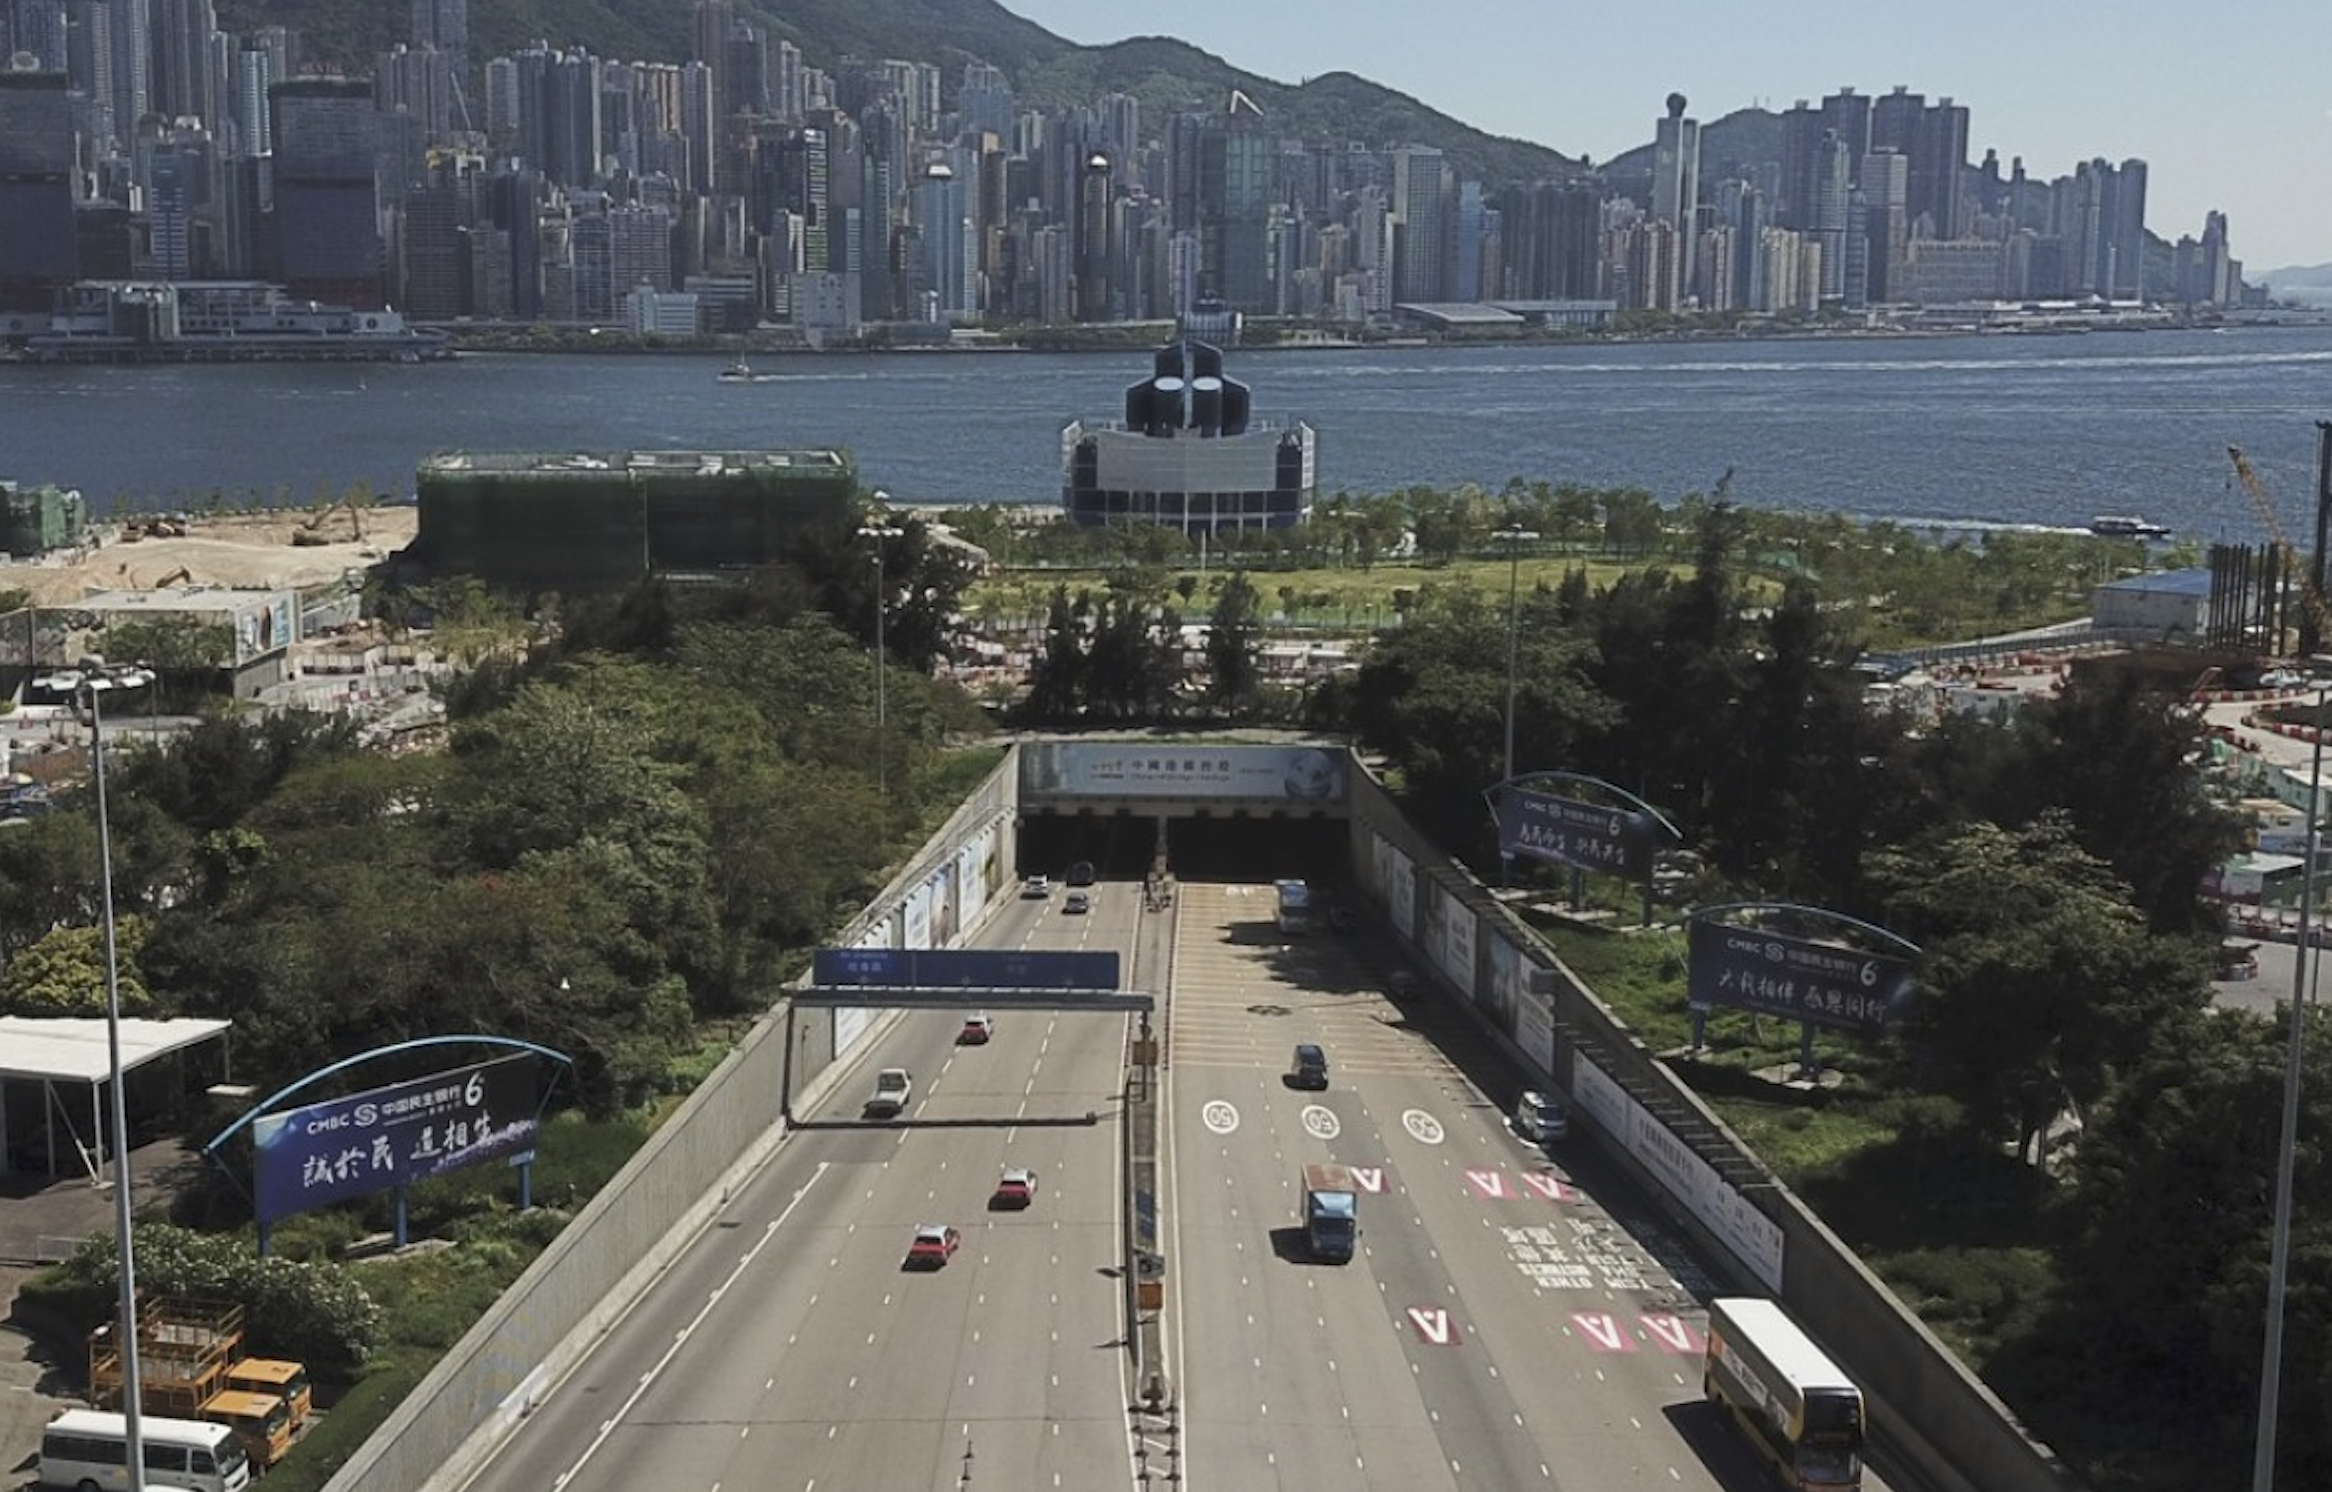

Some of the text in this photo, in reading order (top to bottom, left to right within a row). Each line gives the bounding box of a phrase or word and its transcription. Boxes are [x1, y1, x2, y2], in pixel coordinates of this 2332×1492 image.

[1726, 938, 1762, 954] CMBC
[1860, 960, 1880, 988] 6
[465, 1071, 486, 1106] 6
[306, 1113, 350, 1135] CMBC
[1535, 1276, 1594, 1289] OTHER
